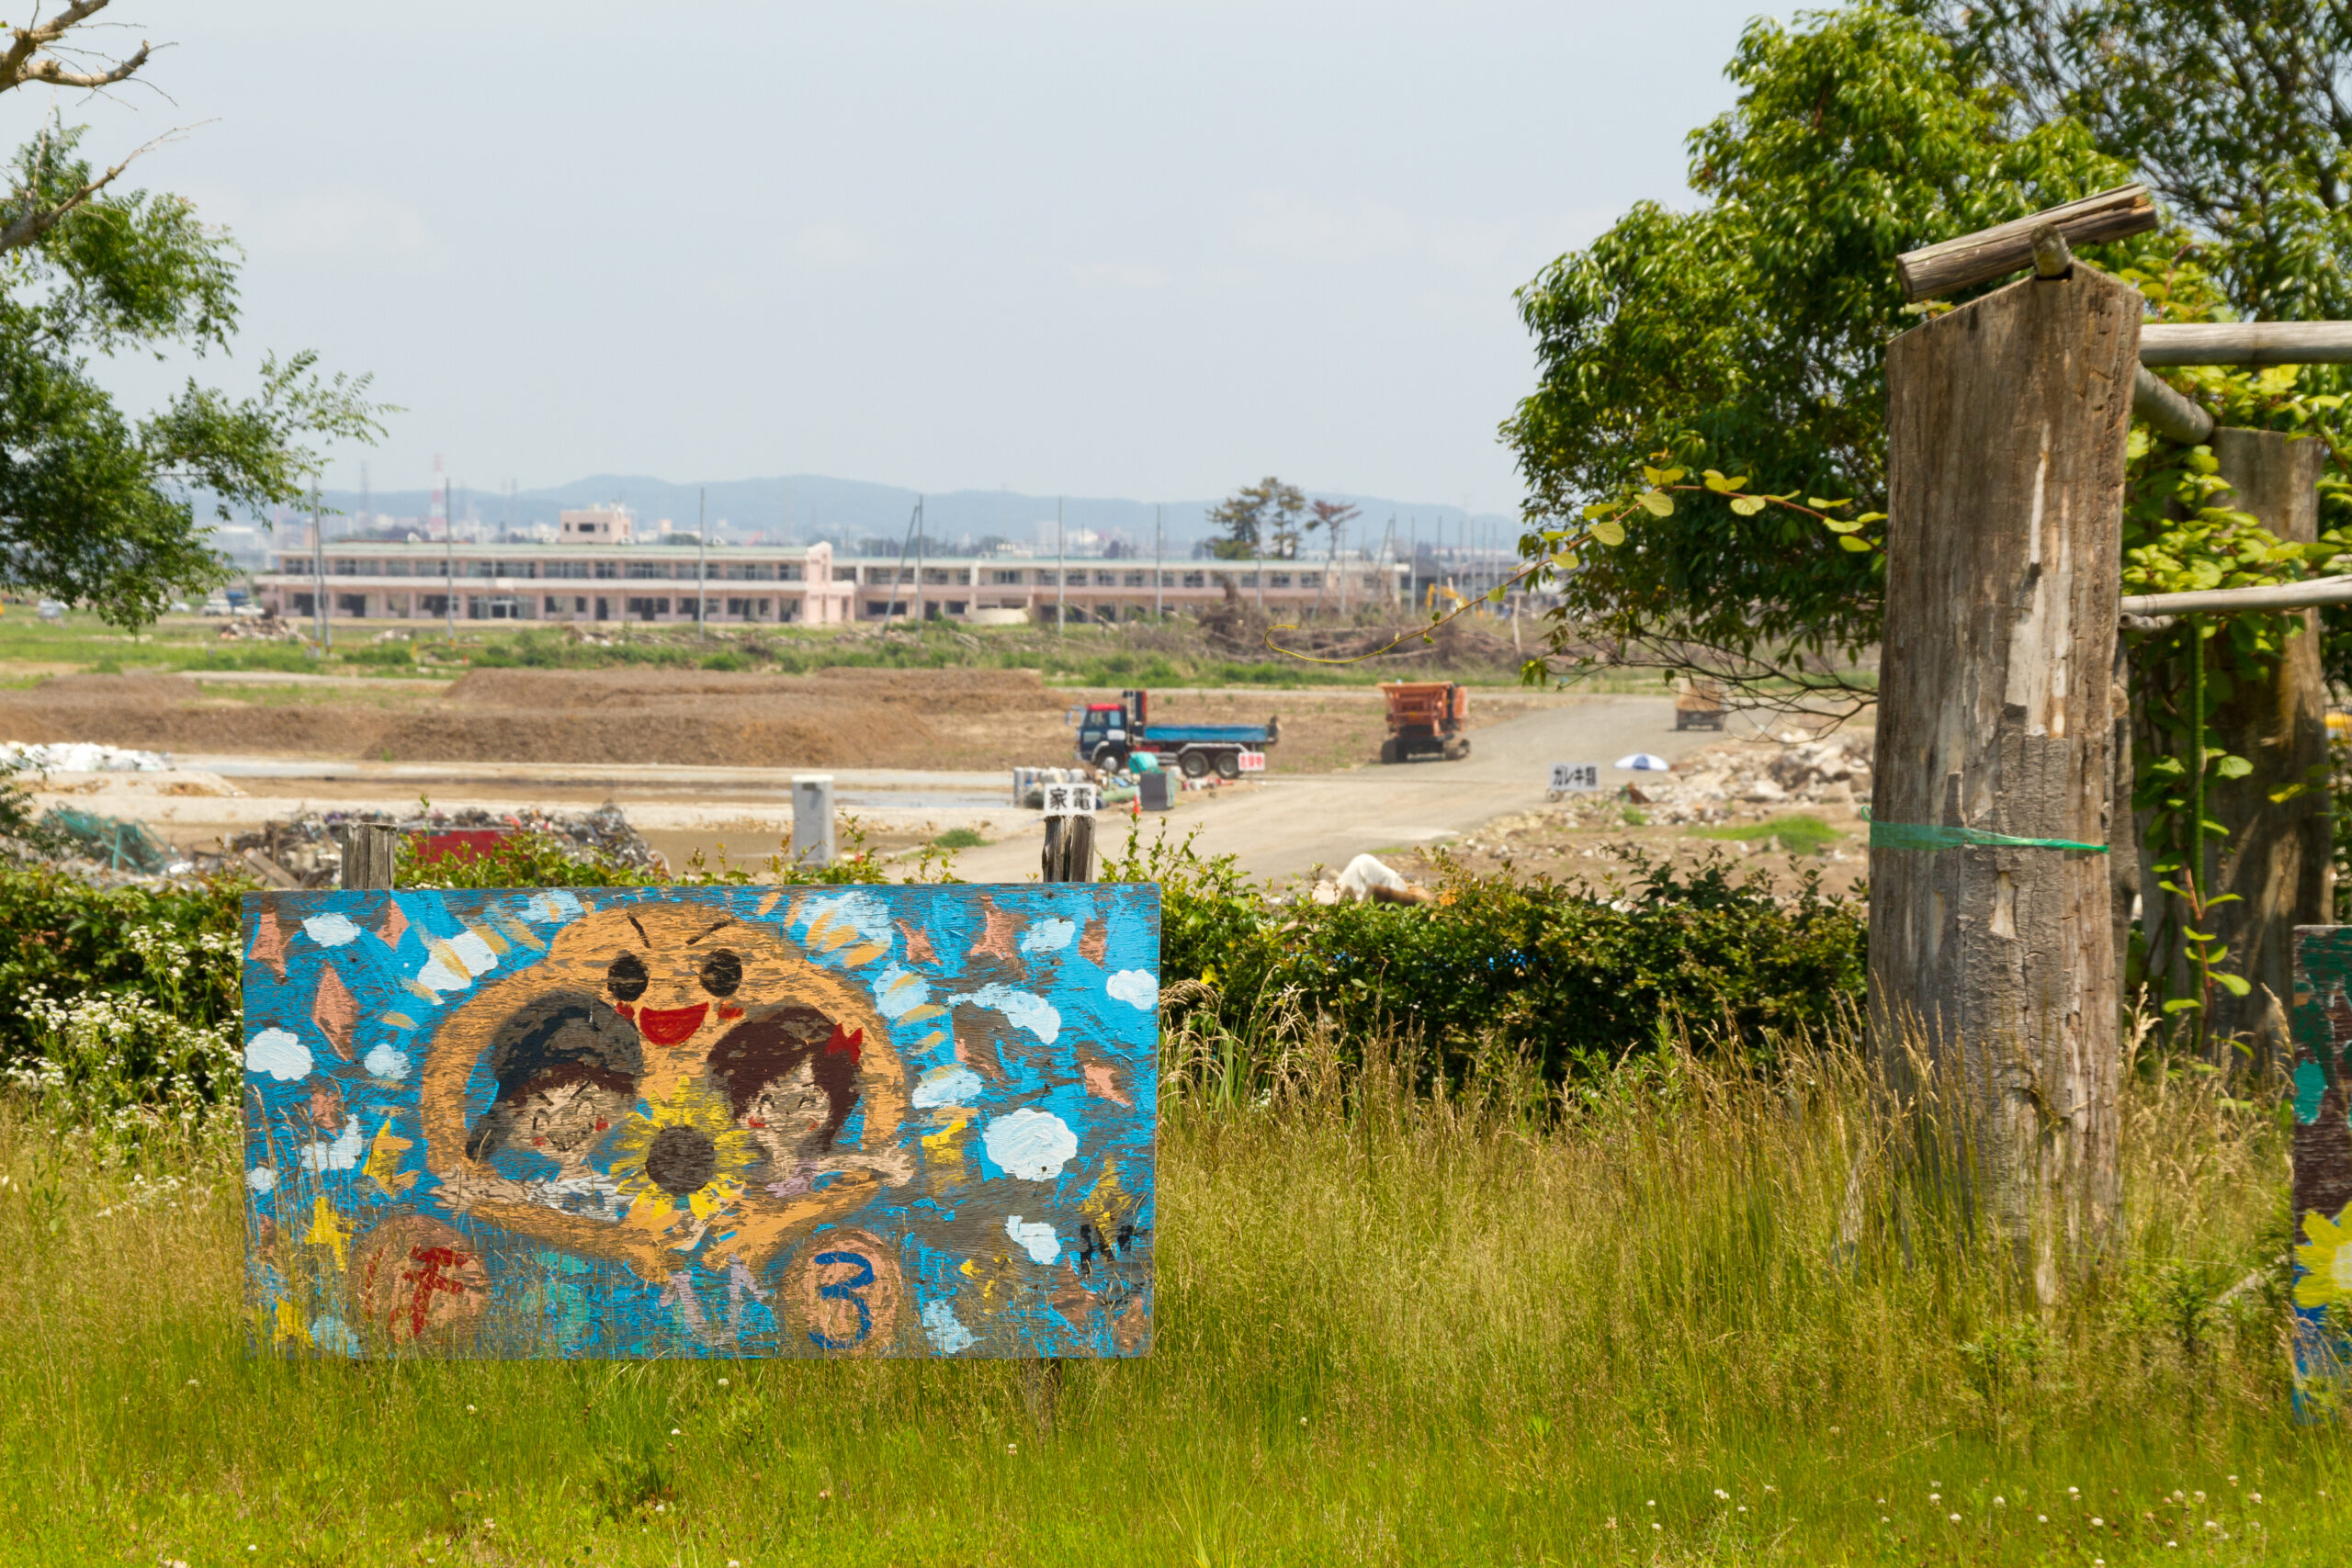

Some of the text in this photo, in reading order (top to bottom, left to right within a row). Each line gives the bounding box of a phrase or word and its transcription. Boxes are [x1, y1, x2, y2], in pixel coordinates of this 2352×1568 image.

[1553, 764, 1598, 787] ガレキ類
[1049, 786, 1091, 811] 家電
